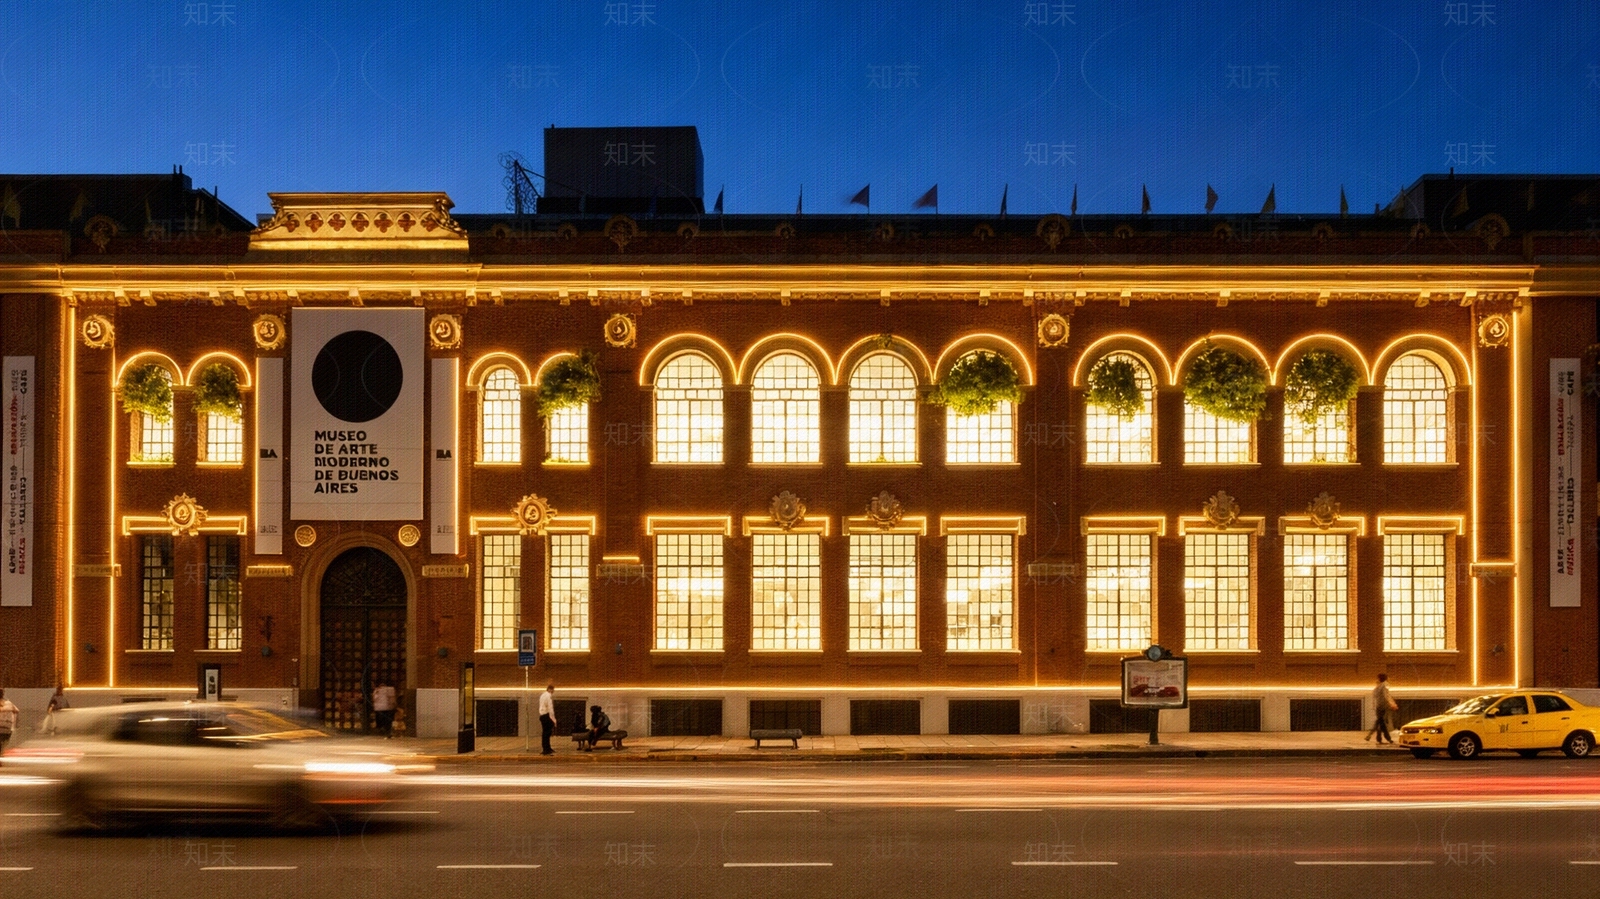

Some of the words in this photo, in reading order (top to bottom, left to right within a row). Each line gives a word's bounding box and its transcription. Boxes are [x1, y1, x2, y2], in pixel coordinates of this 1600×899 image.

[315, 431, 367, 441] MUSEO
[315, 444, 334, 454] DE
[338, 444, 378, 454] ARTE
[315, 457, 389, 467] MODERNO
[315, 470, 333, 480] DE
[338, 470, 399, 480] BUENOS
[314, 483, 358, 493] AIRES
